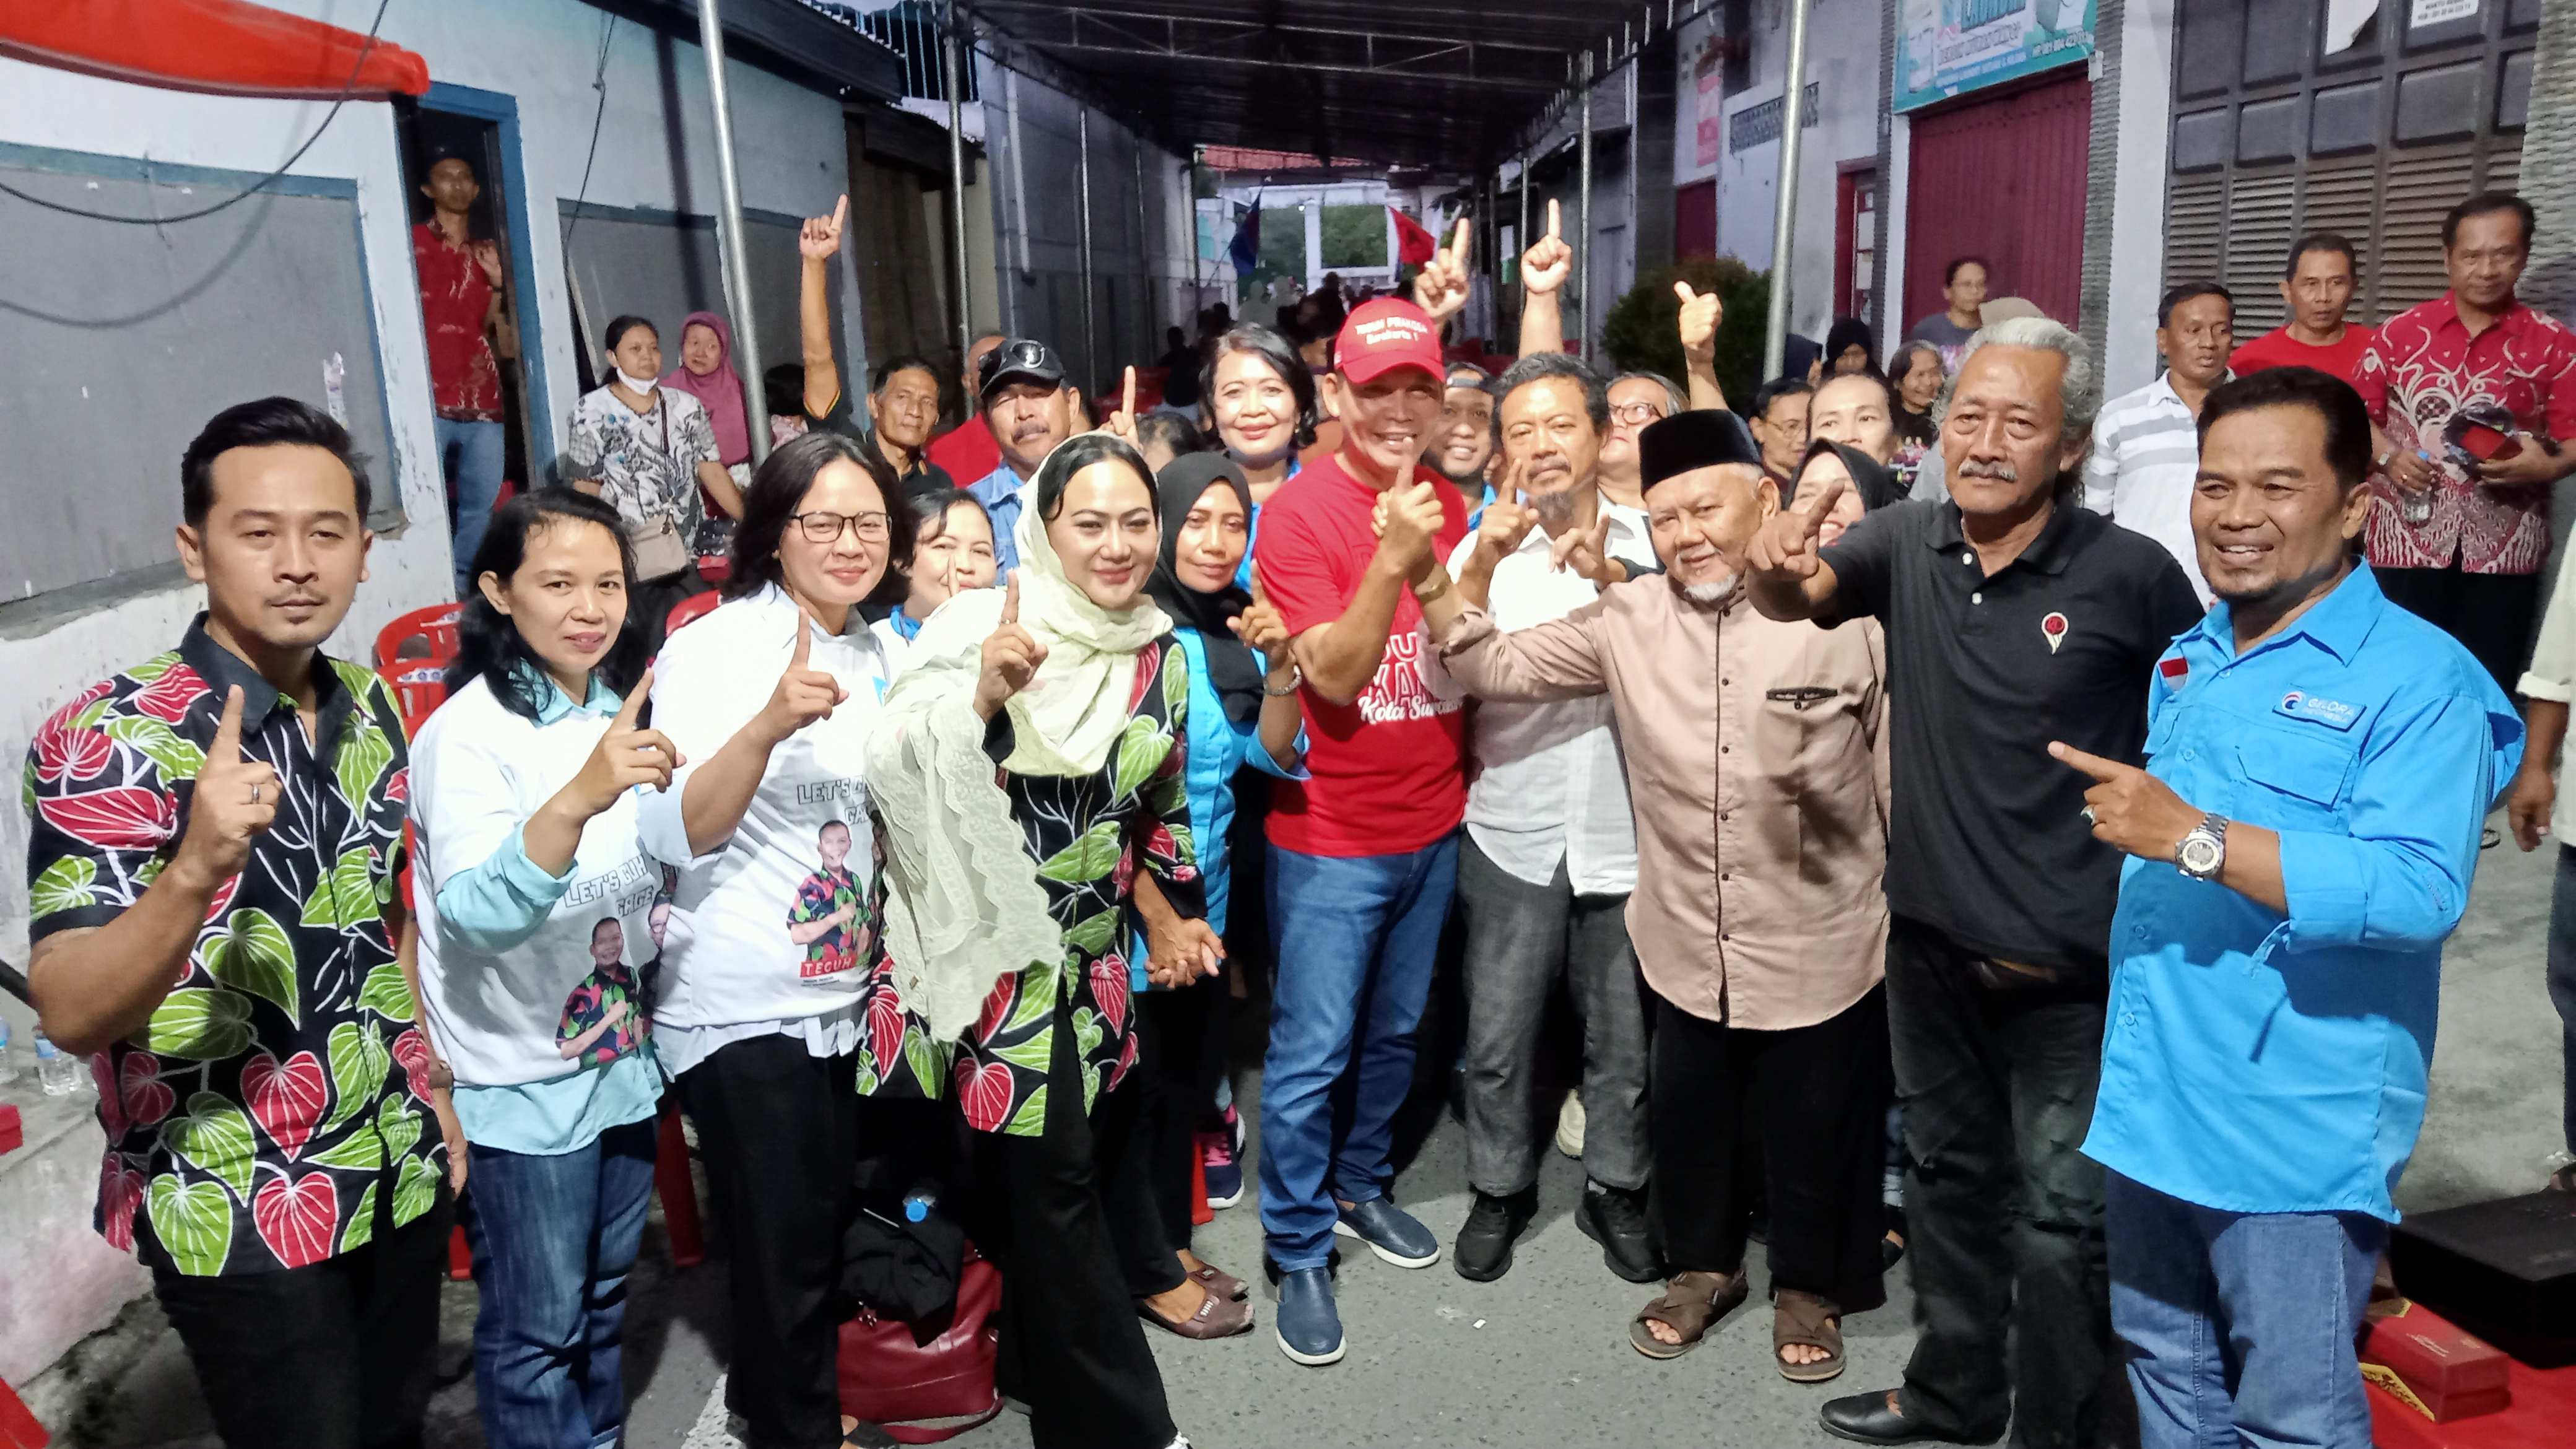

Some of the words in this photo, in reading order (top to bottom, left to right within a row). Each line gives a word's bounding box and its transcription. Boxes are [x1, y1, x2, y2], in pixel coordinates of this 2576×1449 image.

[1357, 695, 1406, 725] Kota
[797, 778, 851, 805] LET'S
[564, 869, 620, 908] LET'S
[804, 957, 851, 976] TEGUH
